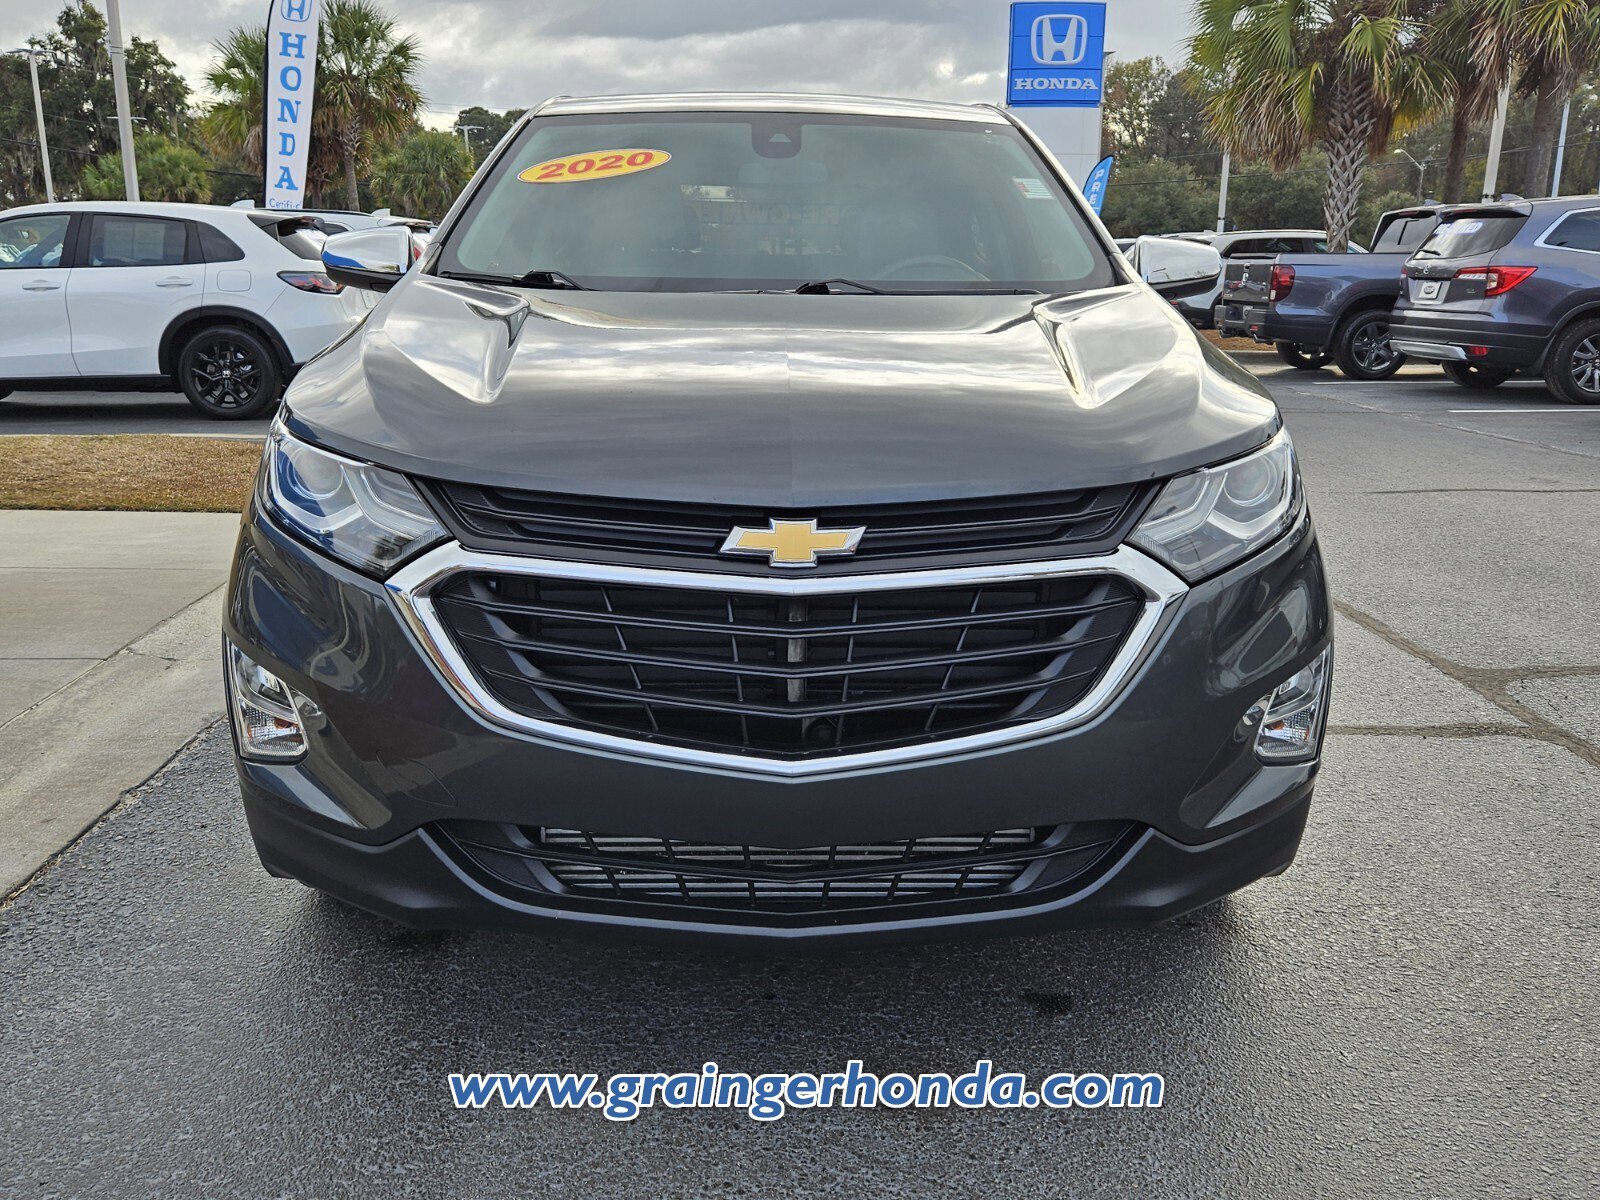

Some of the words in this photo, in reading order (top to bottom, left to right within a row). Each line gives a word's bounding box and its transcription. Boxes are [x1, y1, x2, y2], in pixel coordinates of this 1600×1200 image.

[1013, 77, 1098, 90] HONDA
[274, 31, 307, 191] HONDA
[535, 151, 655, 180] 2020
